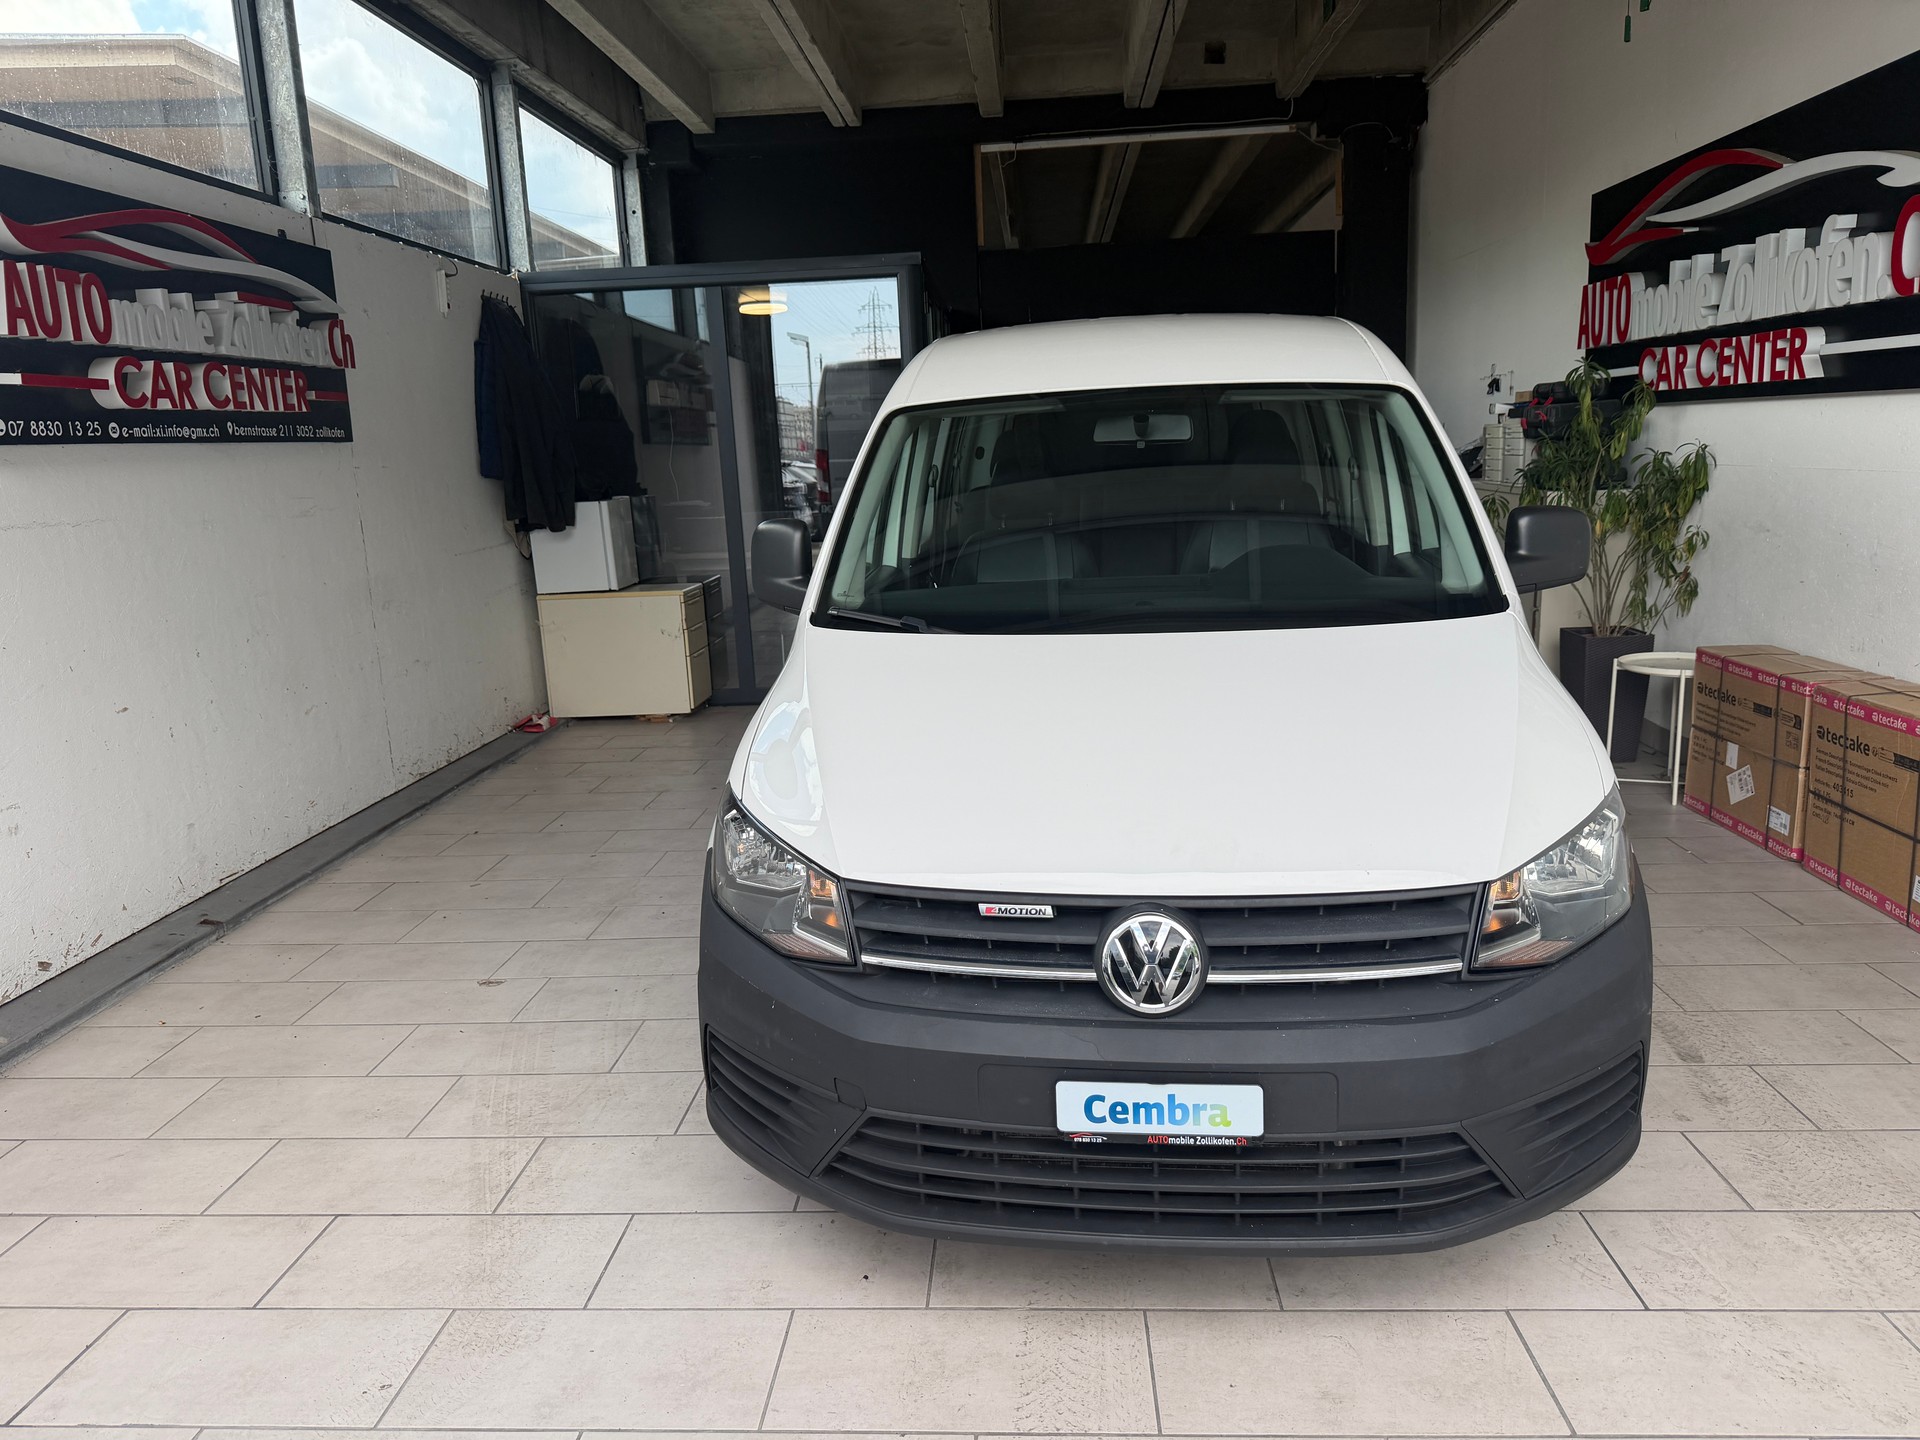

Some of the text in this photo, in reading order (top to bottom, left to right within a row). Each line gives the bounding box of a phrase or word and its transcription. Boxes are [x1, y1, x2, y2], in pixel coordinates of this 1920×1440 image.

[1577, 194, 1920, 349] AUTOmobile Zollikofen.C
[3, 260, 215, 353] AUTOmobile
[1638, 327, 1808, 391] CAR CENTER
[114, 356, 311, 412] CAR CENTER
[8, 420, 24, 436] 07
[30, 420, 63, 436] 8830
[68, 420, 82, 436] 13
[86, 421, 101, 436] 25
[234, 425, 277, 437] bernstrasse
[279, 425, 294, 437] 211
[296, 425, 314, 437] 3052
[315, 428, 345, 438] zollikofen
[1879, 714, 1907, 730] tectake
[1833, 782, 1854, 798] 40315
[1852, 882, 1878, 903] tectake
[1083, 1094, 1231, 1128] Cembra
[1147, 1136, 1194, 1145] AUTOmobile
[1196, 1136, 1247, 1146] Zollikofen.Ch
